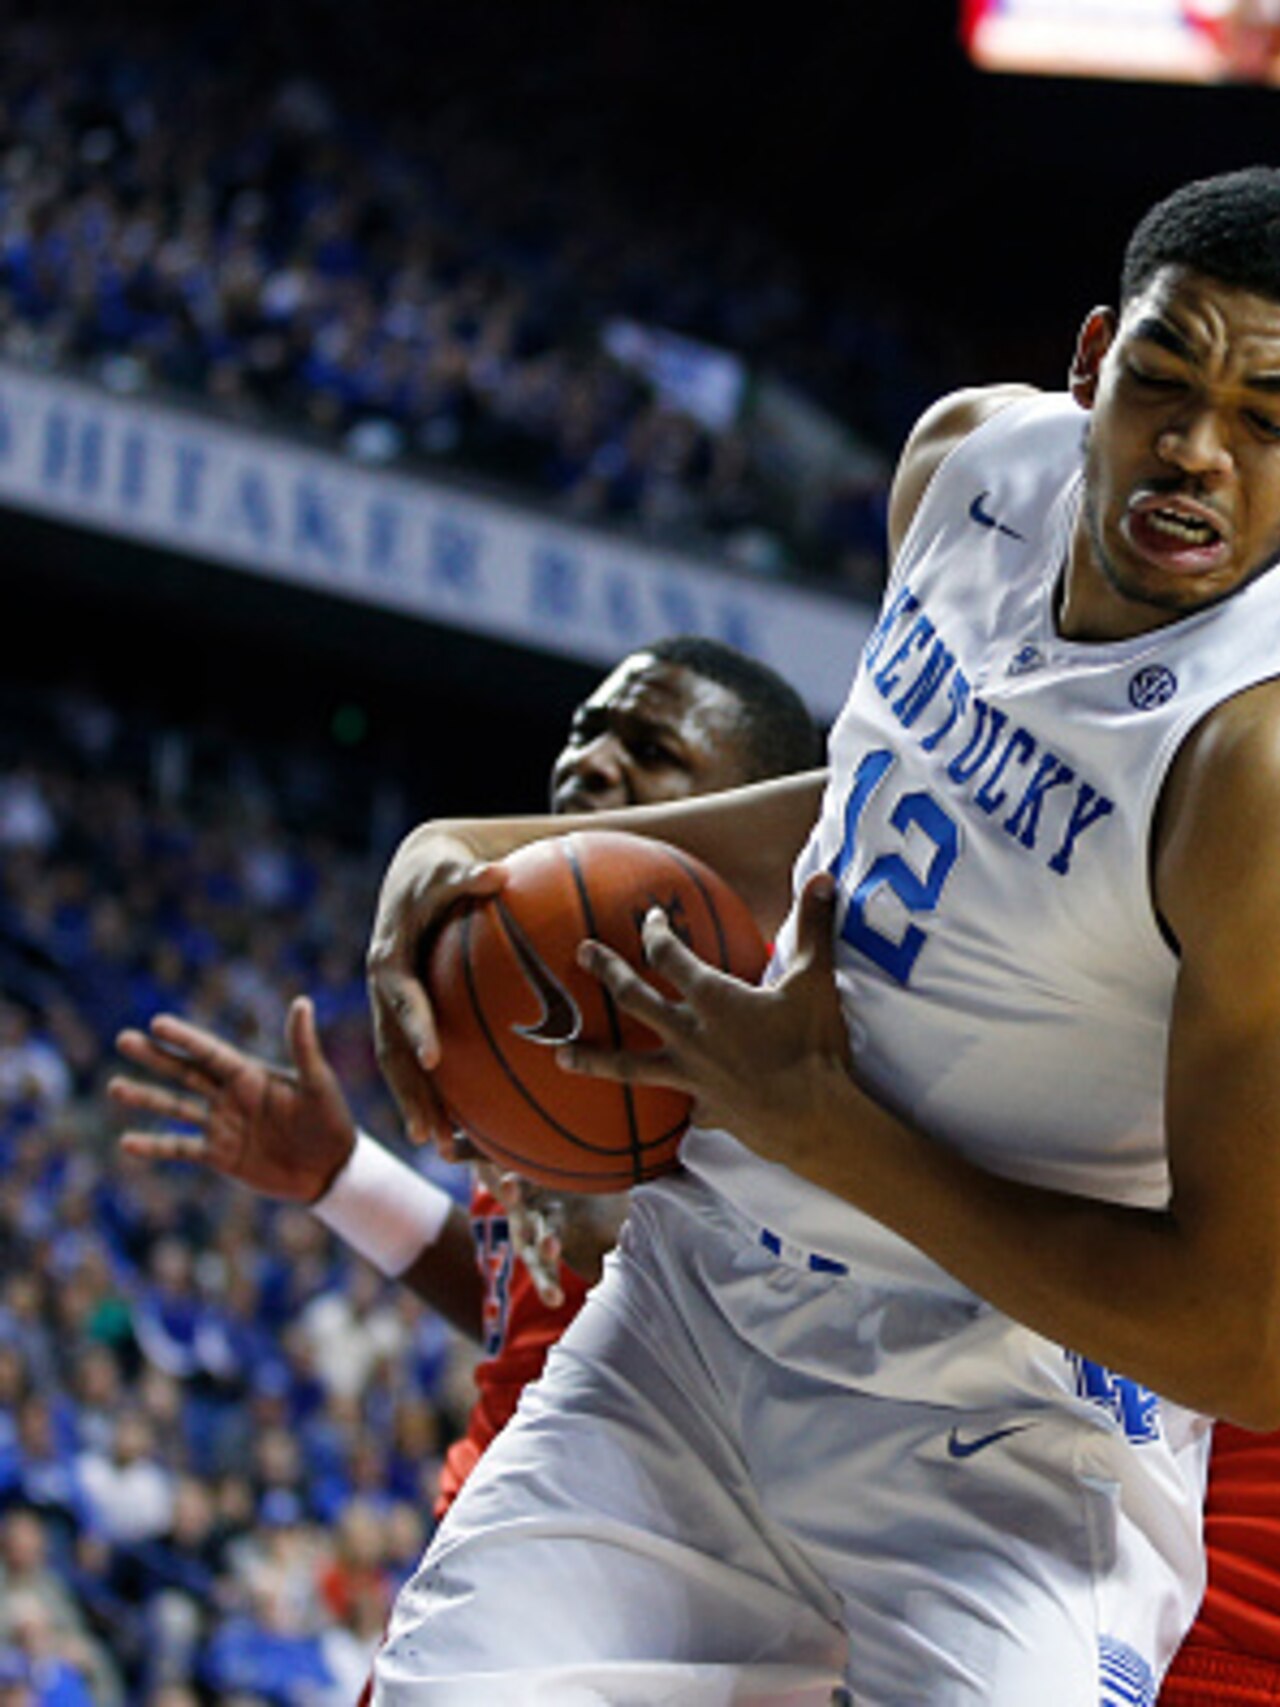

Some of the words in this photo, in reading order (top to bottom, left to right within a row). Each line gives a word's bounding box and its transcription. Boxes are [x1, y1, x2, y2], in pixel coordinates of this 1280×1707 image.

[0, 394, 485, 596] HITAKER
[865, 585, 1114, 876] KENTUCKY
[829, 749, 959, 988] 12
